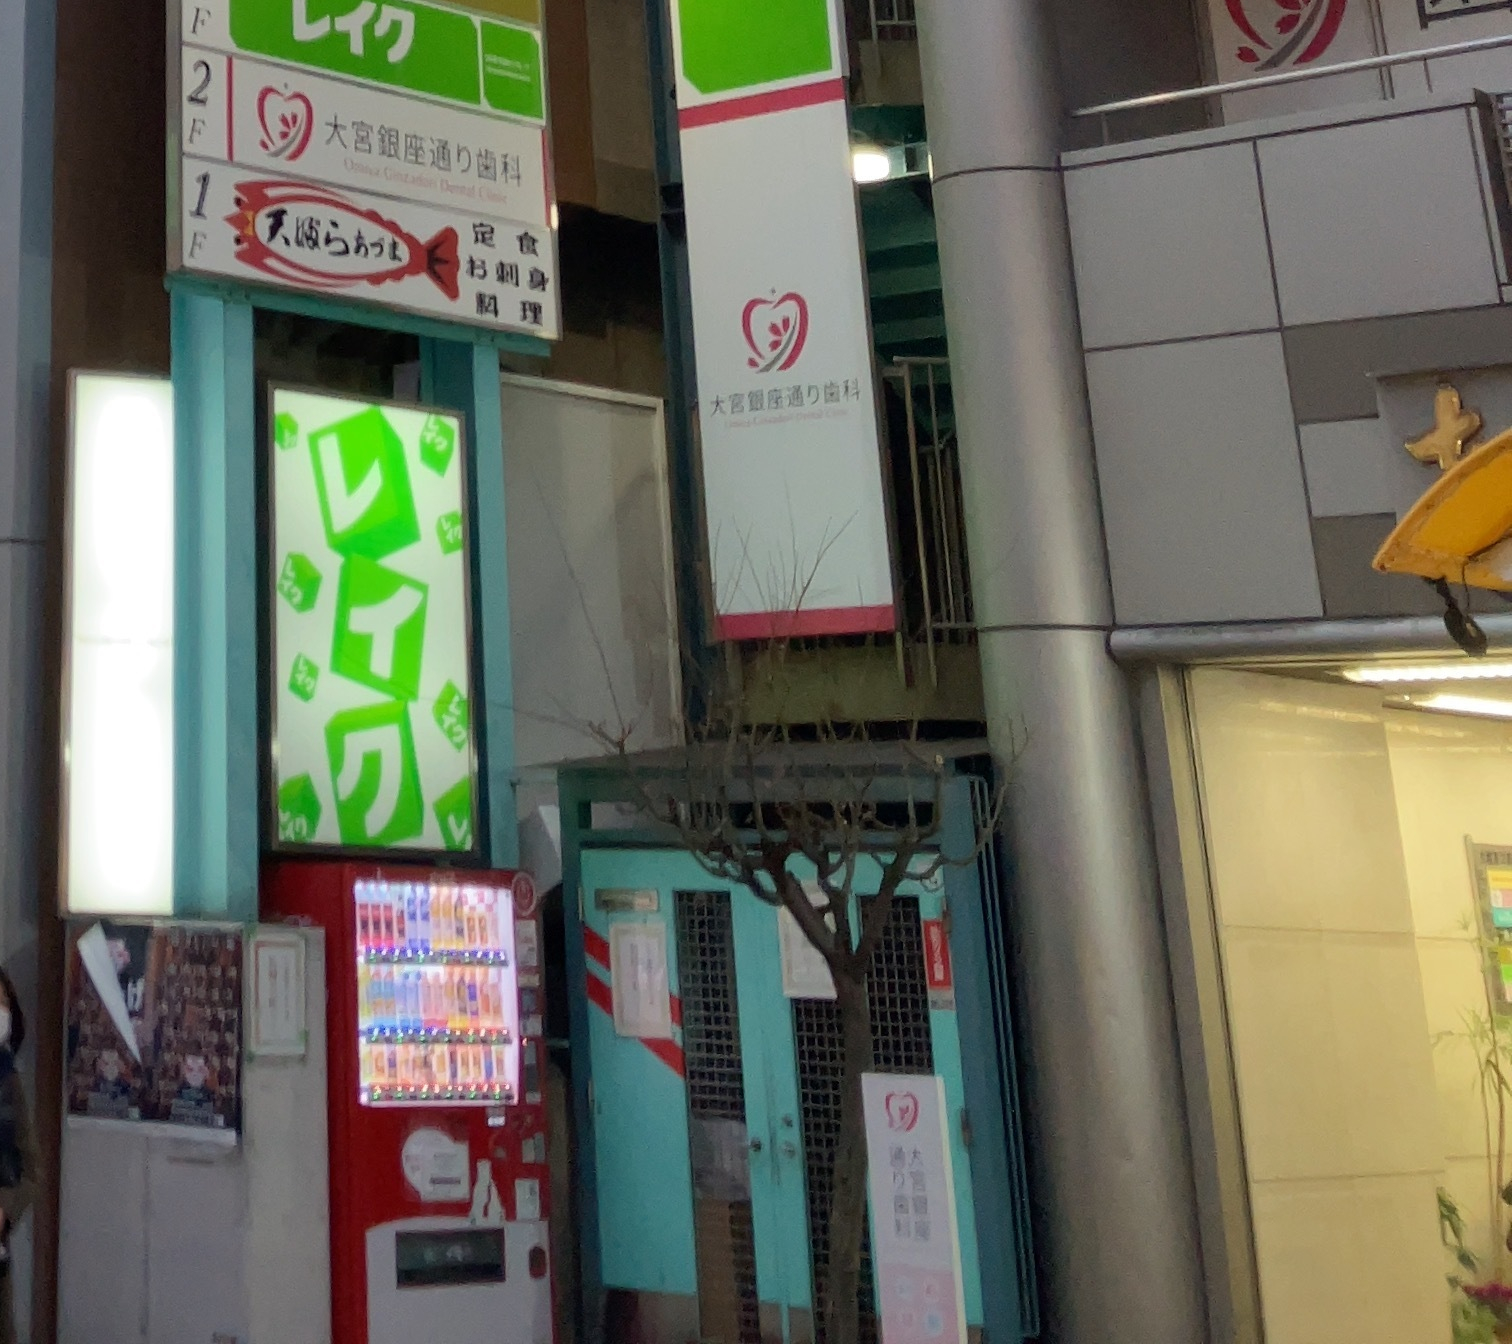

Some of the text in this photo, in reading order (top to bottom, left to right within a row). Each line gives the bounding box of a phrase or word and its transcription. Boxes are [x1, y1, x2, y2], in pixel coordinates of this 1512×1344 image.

[324, 111, 522, 188] 大宮銀座通り歯科
[710, 377, 861, 418] 大宮銀座通り歯科
[317, 432, 425, 839] レイク
